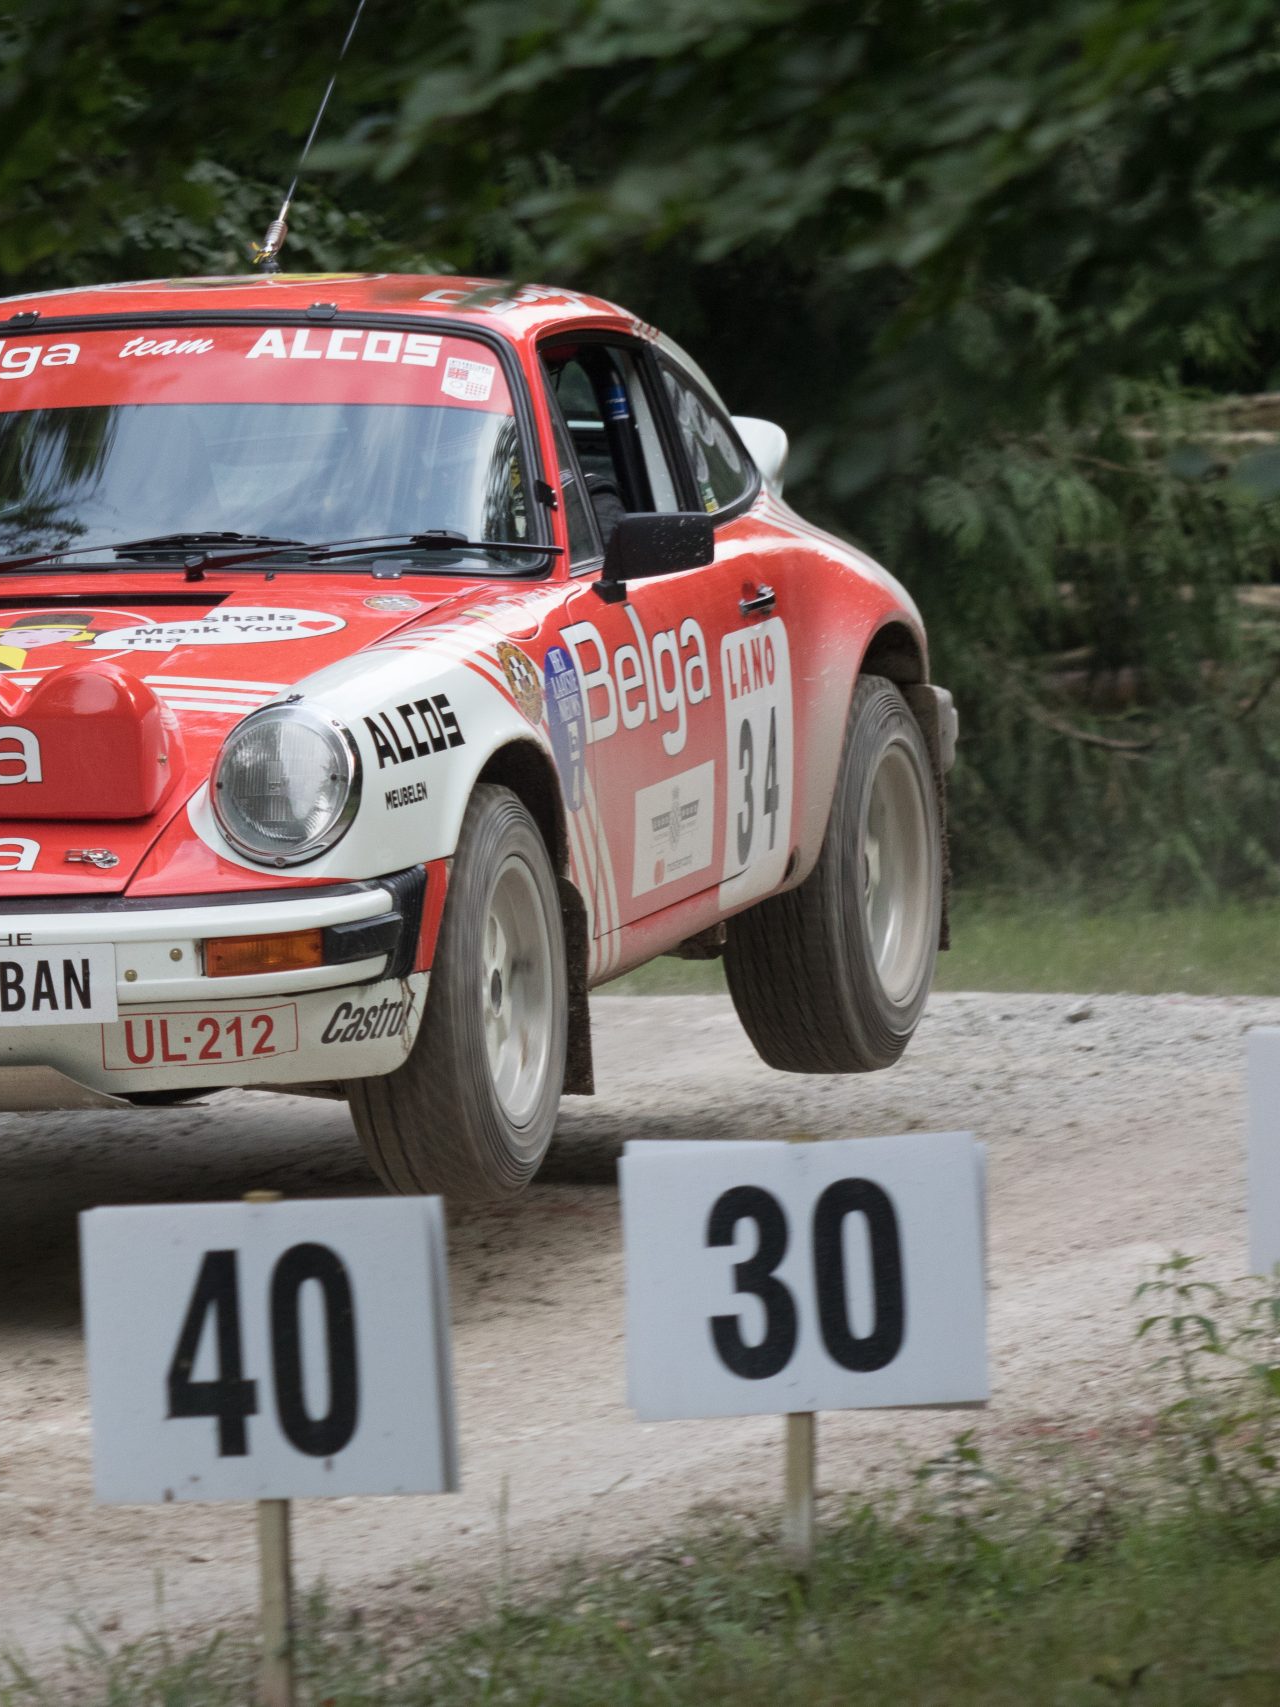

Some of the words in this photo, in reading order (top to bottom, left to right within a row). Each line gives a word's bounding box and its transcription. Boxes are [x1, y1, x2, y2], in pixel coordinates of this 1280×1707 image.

[118, 336, 215, 358] team
[245, 329, 443, 367] ALCOS
[559, 603, 711, 756] Belga
[725, 634, 775, 700] LANO
[362, 693, 466, 769] ALCOS
[737, 706, 780, 866] 34
[385, 781, 428, 810] MEUBELEN
[706, 1177, 906, 1380] 30
[165, 1241, 361, 1458] 40
